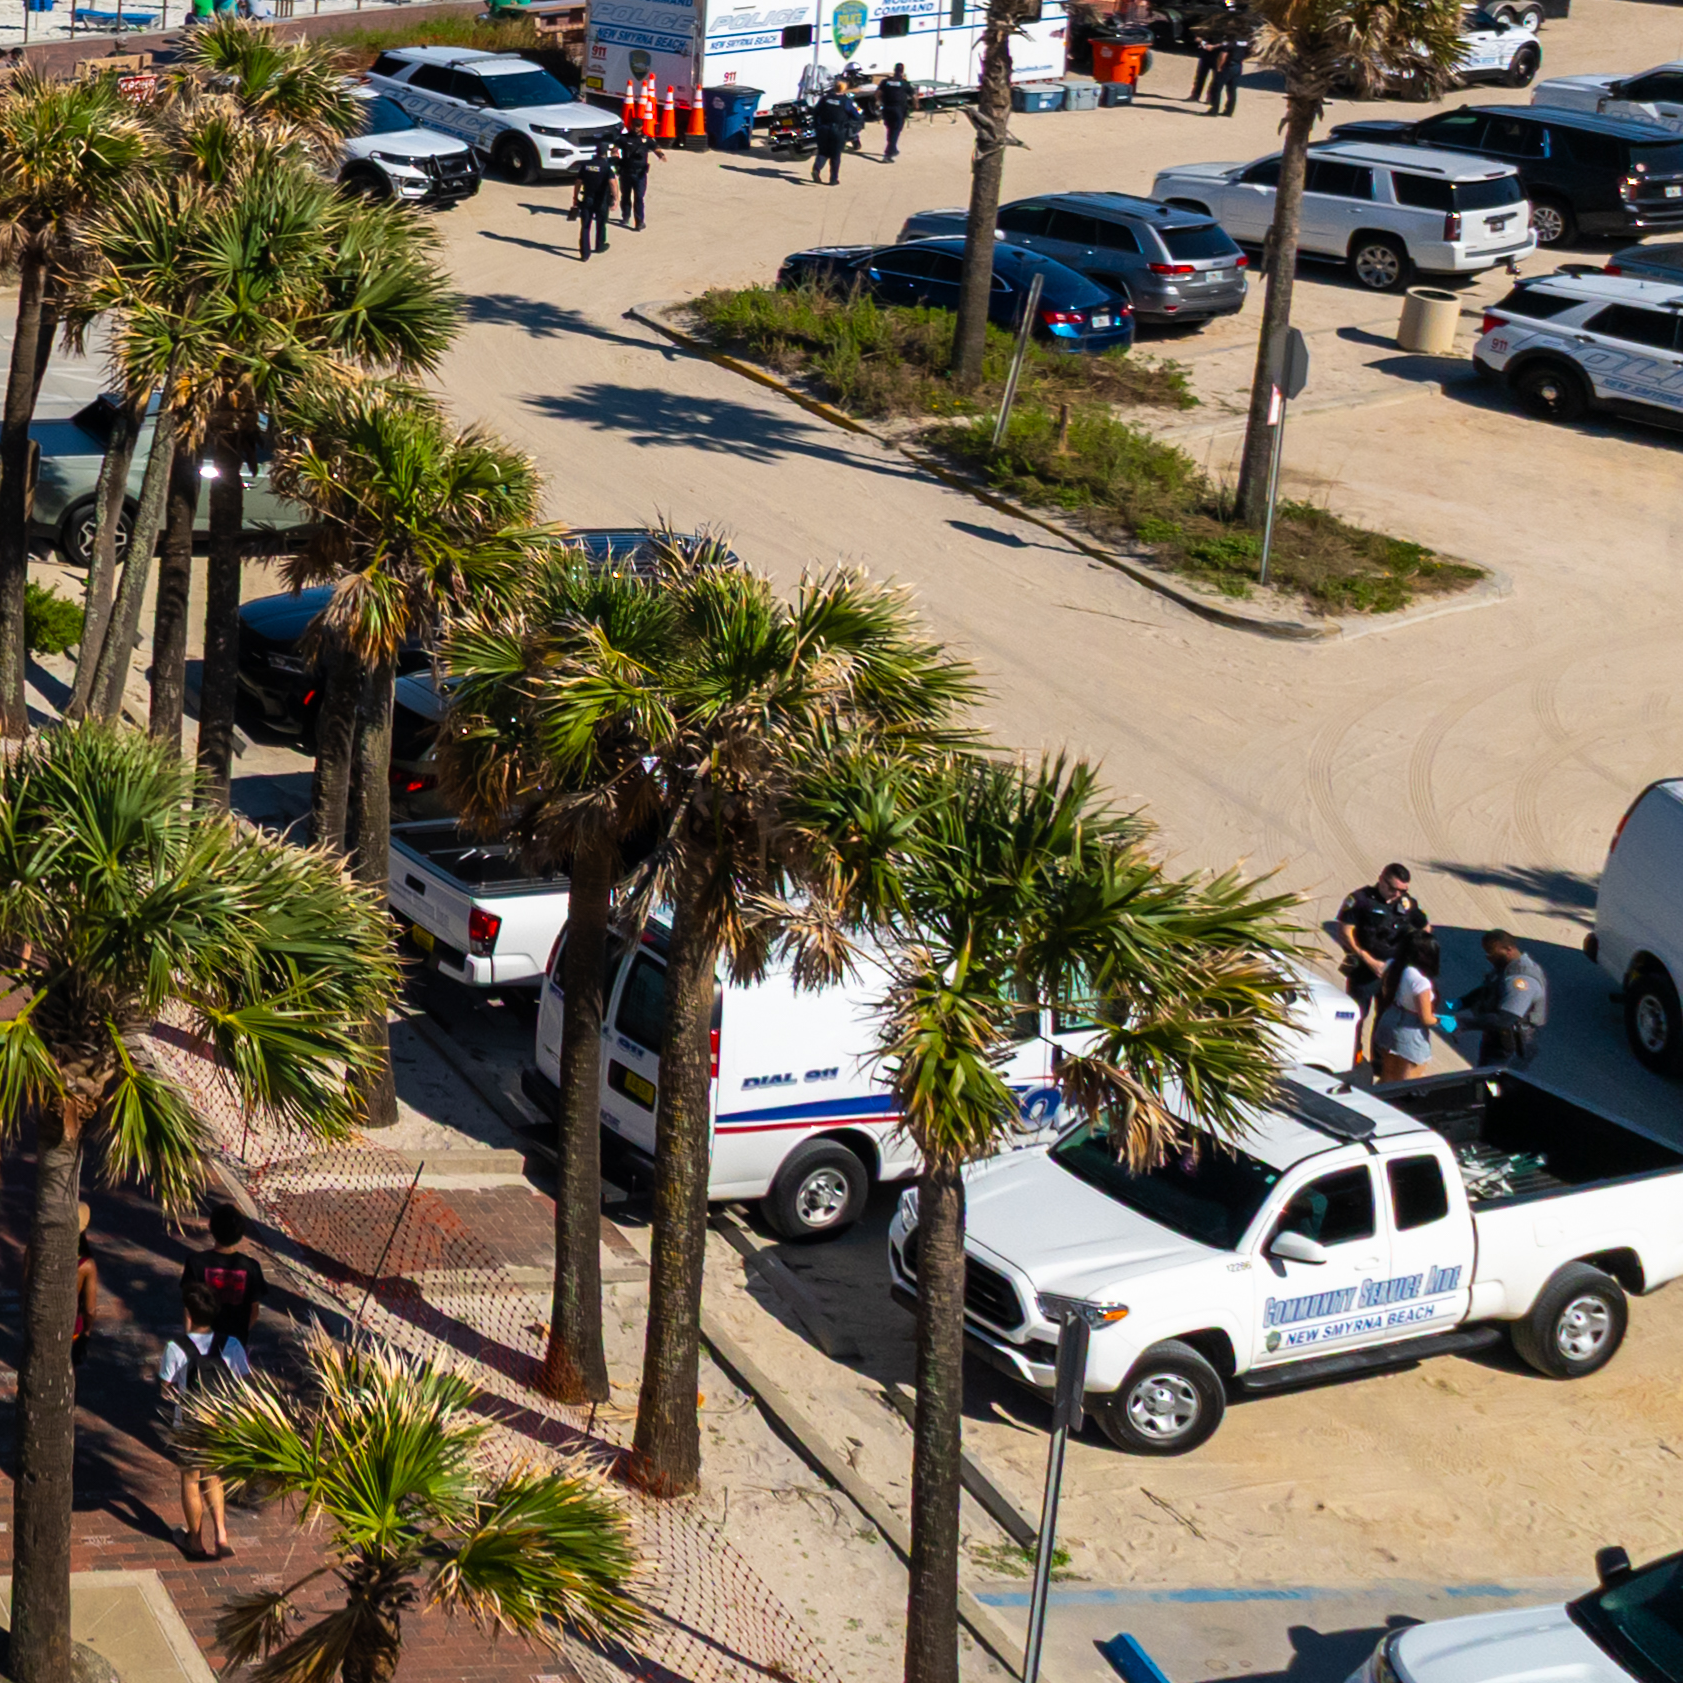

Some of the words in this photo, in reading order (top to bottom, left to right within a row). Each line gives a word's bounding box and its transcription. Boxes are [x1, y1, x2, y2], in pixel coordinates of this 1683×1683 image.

[593, 3, 696, 32] POLICE
[874, 3, 934, 16] COMMAND
[708, 7, 810, 32] POLICE
[597, 28, 618, 39] NEW
[618, 31, 653, 45] SMYRNA
[655, 36, 687, 51] BEACH
[710, 41, 726, 50] NEW
[754, 35, 777, 45] BEACH
[591, 46, 607, 56] 911
[723, 71, 737, 82] 911
[1491, 338, 1508, 351] 911
[1603, 378, 1629, 393] NEW
[741, 1072, 798, 1091] DIAL
[803, 1066, 839, 1083] 911
[1263, 1287, 1358, 1328] COMMUNITY
[1358, 1273, 1423, 1309] SERVICE
[1424, 1265, 1462, 1295] AIDE
[1286, 1329, 1320, 1346] NEW
[1322, 1316, 1383, 1339] SMYRNA
[1388, 1305, 1436, 1325] BEACH
